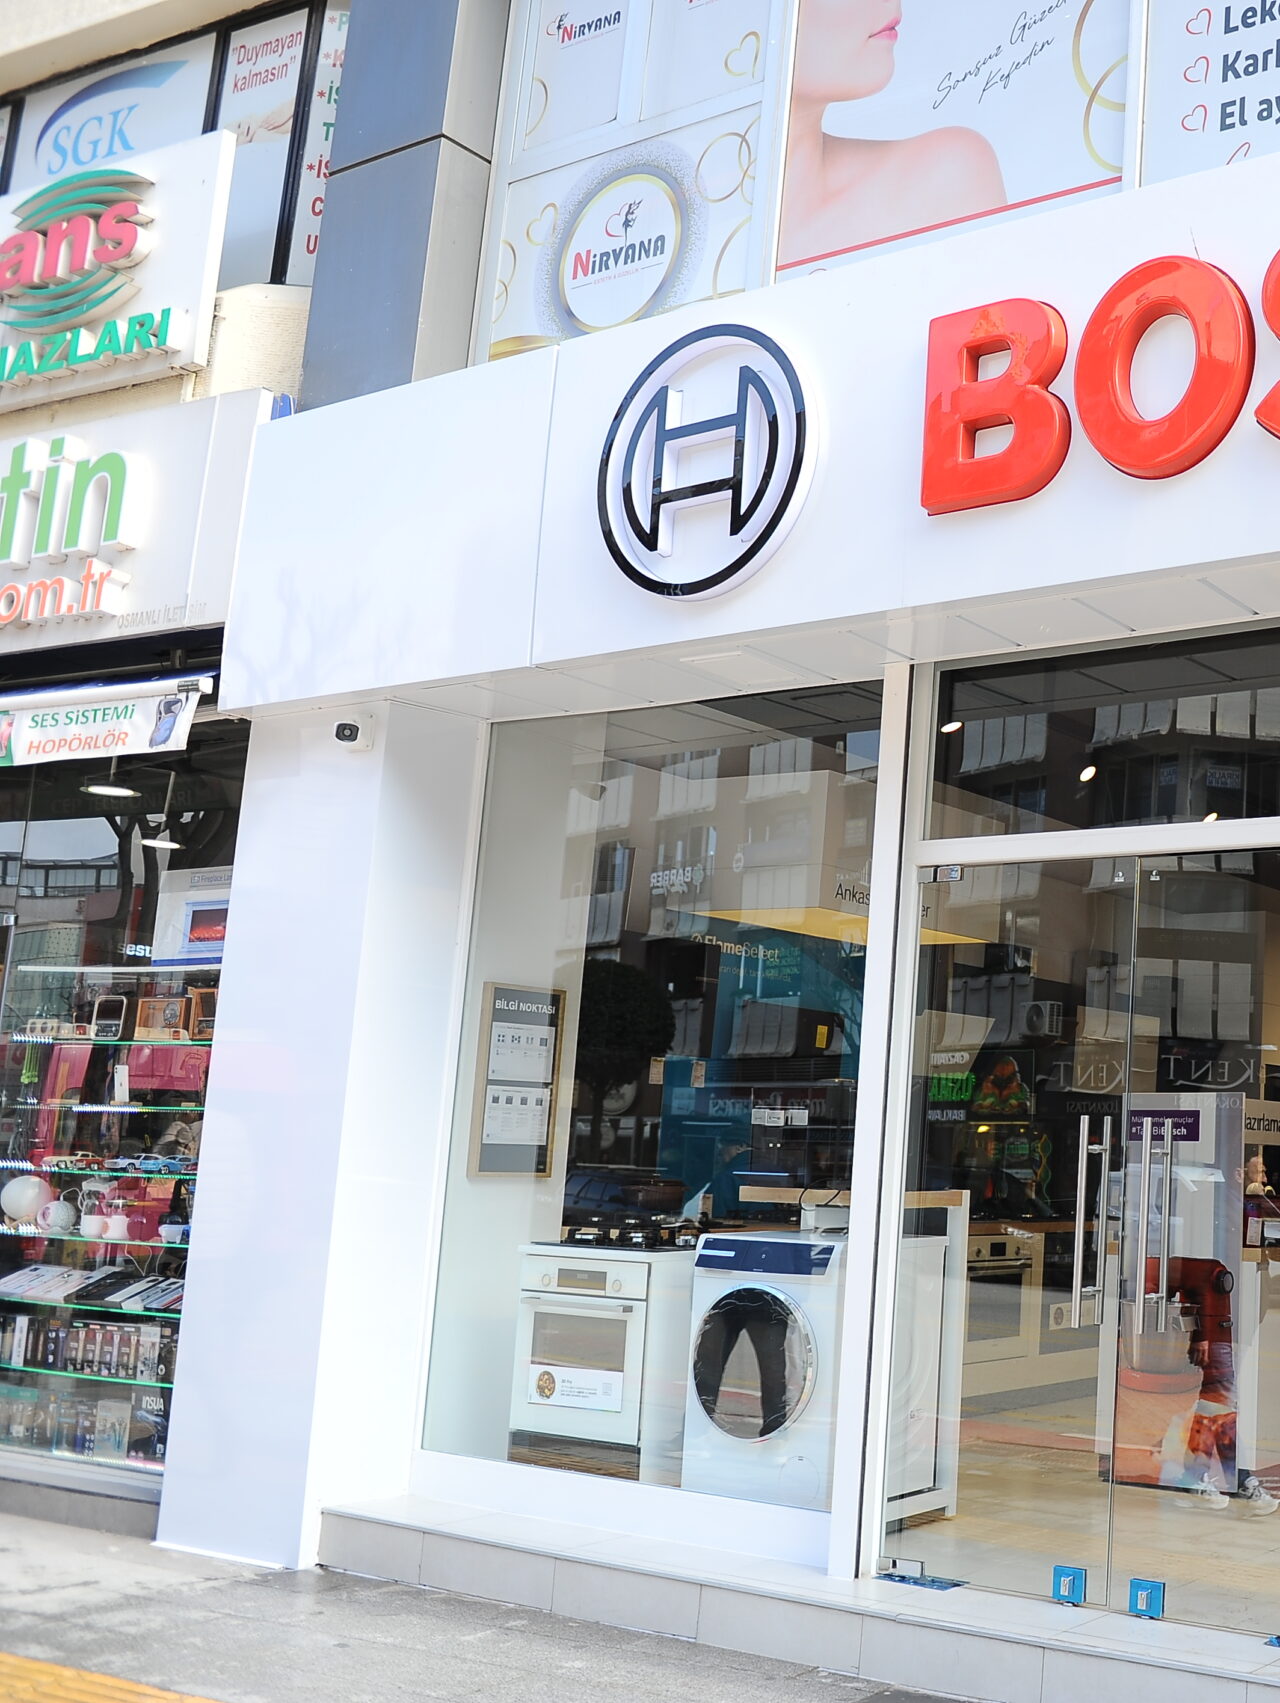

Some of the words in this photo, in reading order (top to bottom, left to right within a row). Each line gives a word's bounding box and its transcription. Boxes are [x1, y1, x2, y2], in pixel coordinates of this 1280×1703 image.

[1219, 96, 1248, 132] El
[47, 104, 140, 176] SGK
[28, 711, 61, 730] SES
[27, 728, 129, 755] HOPÖRLÖR
[495, 998, 518, 1011] BİLGİ
[519, 1002, 556, 1015] NOKTASI
